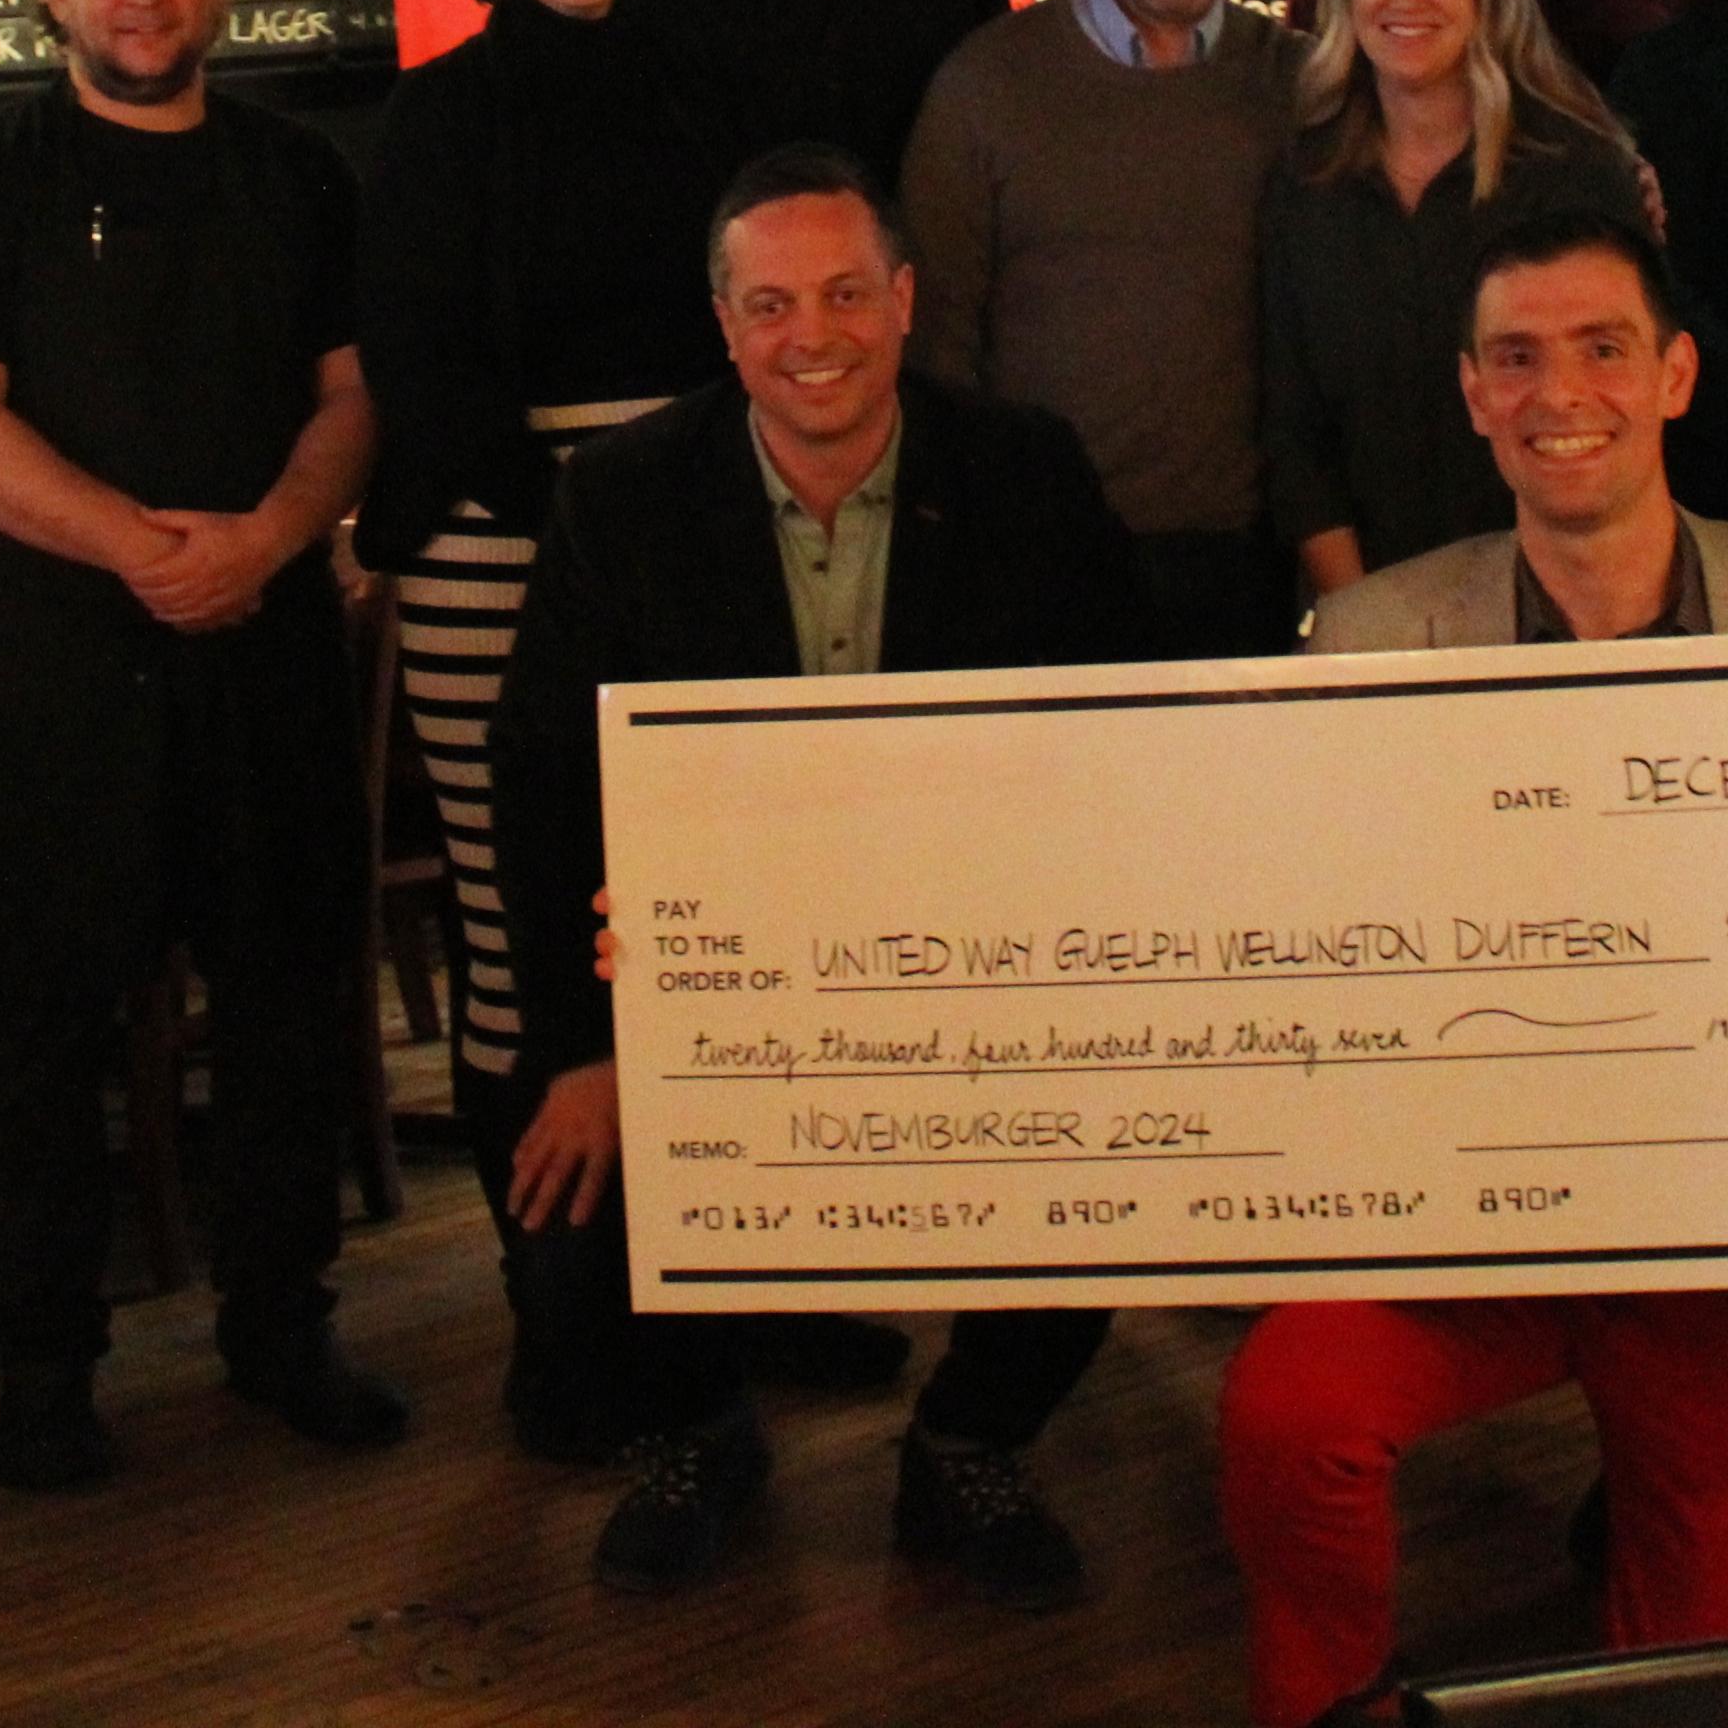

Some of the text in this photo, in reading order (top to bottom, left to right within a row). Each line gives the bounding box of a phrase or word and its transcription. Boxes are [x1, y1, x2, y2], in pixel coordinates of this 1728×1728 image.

[230, 8, 334, 43] LAGER
[1493, 786, 1572, 812] DATE:
[653, 900, 702, 921] PAY
[655, 935, 745, 956] TO THE
[657, 916, 1652, 993] ORDER OF: UNITED WAY GUELPH WELLINGTON DUFFERIN
[690, 1030, 808, 1084] twenty
[961, 1028, 1032, 1084] four
[1040, 1022, 1155, 1064] hundred
[1164, 1022, 1214, 1059] and
[1223, 1018, 1322, 1078] thirty
[1332, 1026, 1412, 1054] seven
[668, 1104, 1212, 1161] MEMO: NOVEMBURGER 2024
